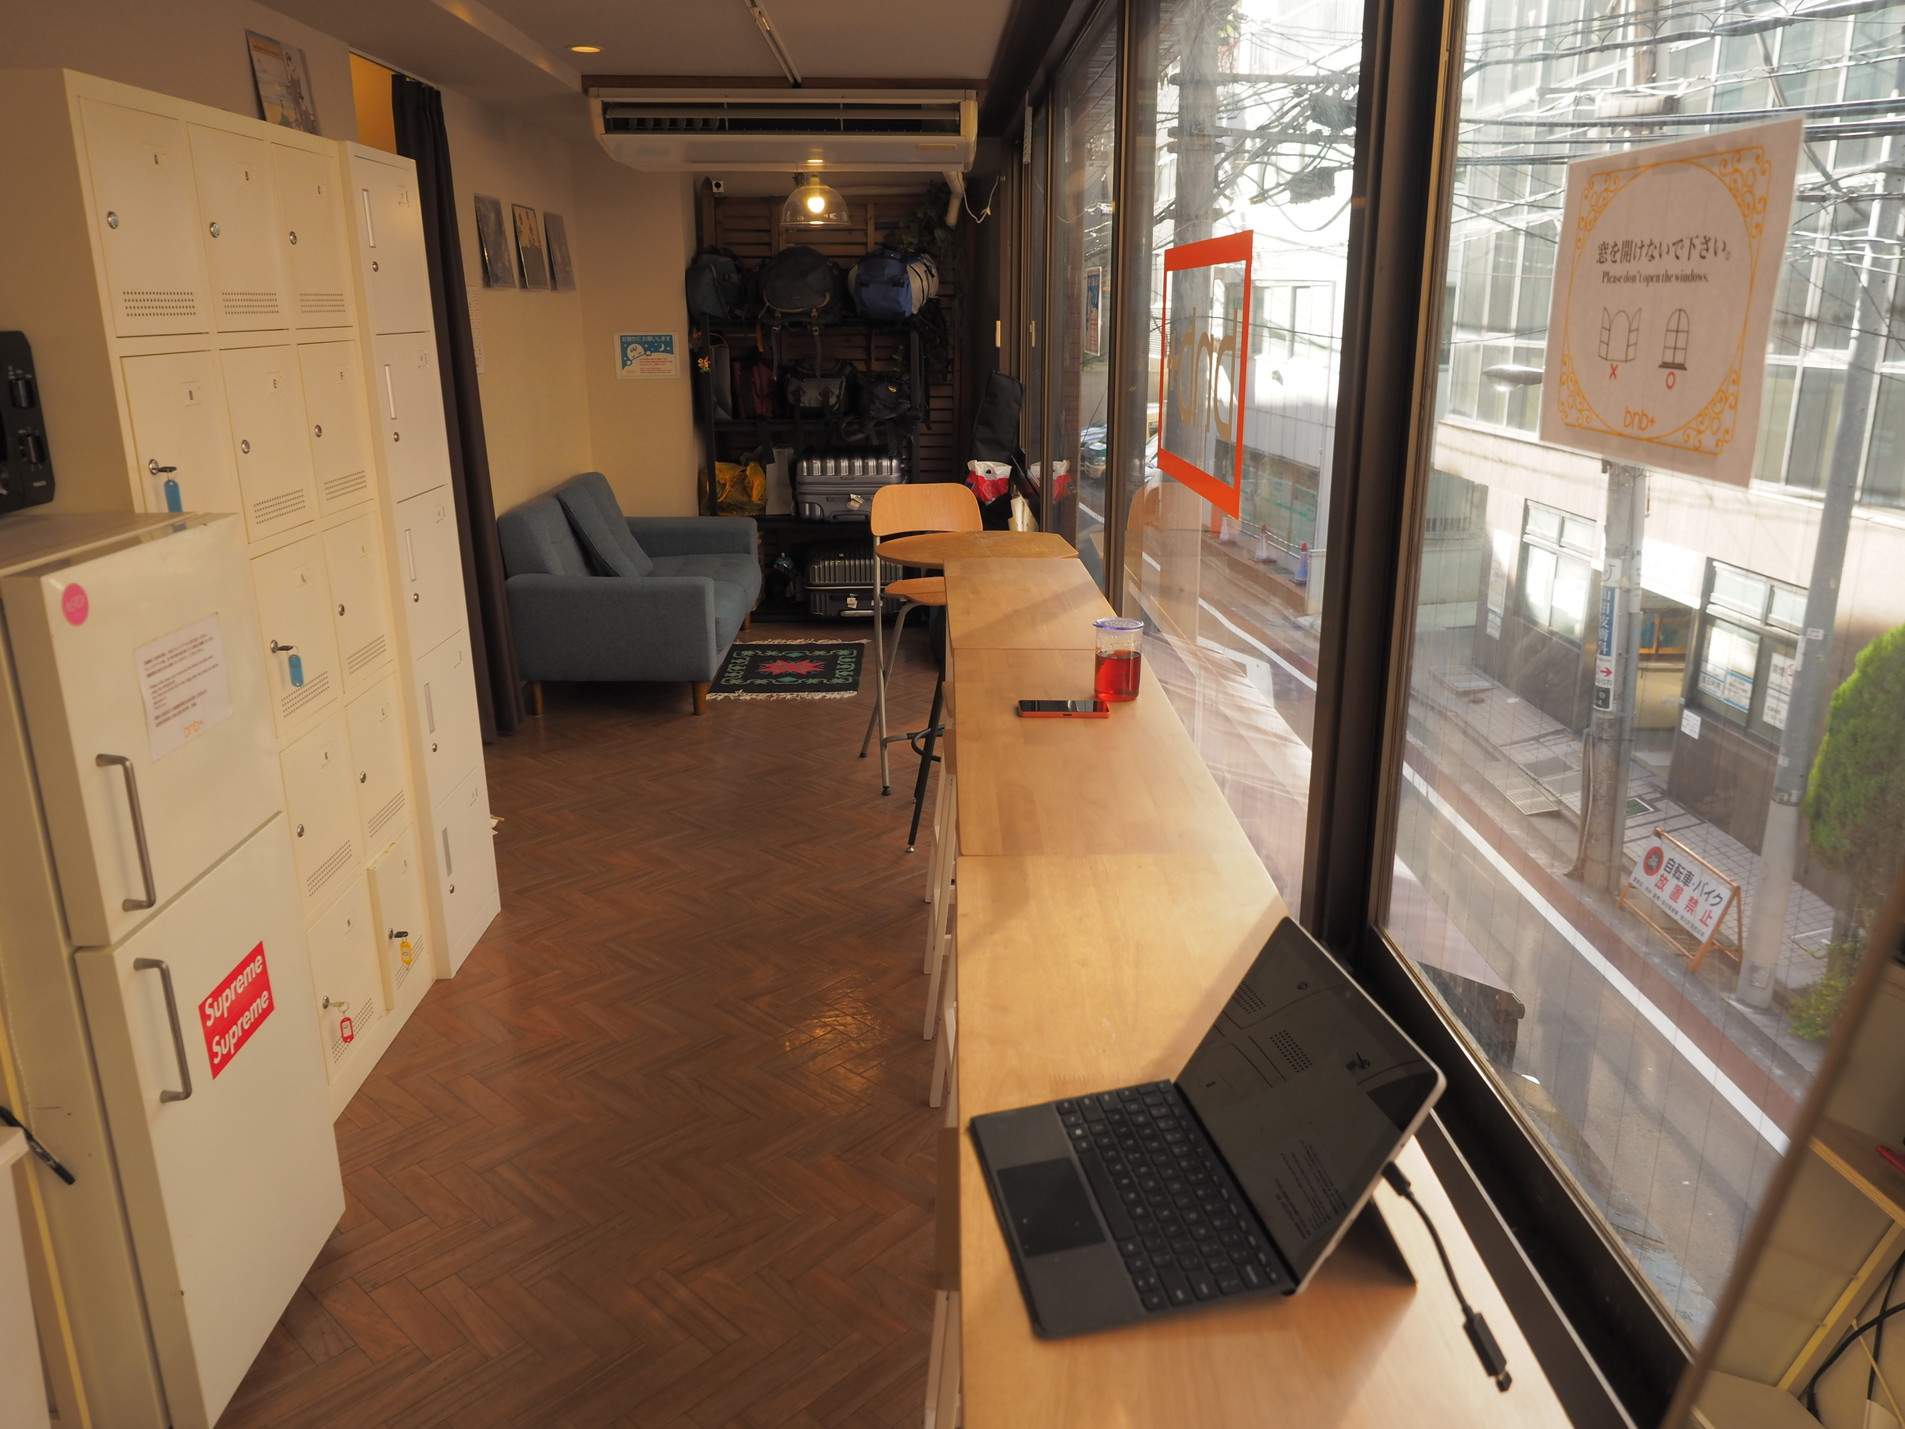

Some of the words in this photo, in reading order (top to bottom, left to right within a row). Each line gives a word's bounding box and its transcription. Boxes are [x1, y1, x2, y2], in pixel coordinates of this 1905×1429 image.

[1596, 234, 1731, 264] 窓を開けないで下さい。
[1602, 270, 1621, 284] Please
[1643, 272, 1661, 288] open
[1661, 269, 1673, 283] the
[1654, 874, 1714, 928] 放置禁止
[205, 955, 263, 1027] Supreme
[212, 990, 269, 1065] Supreme
